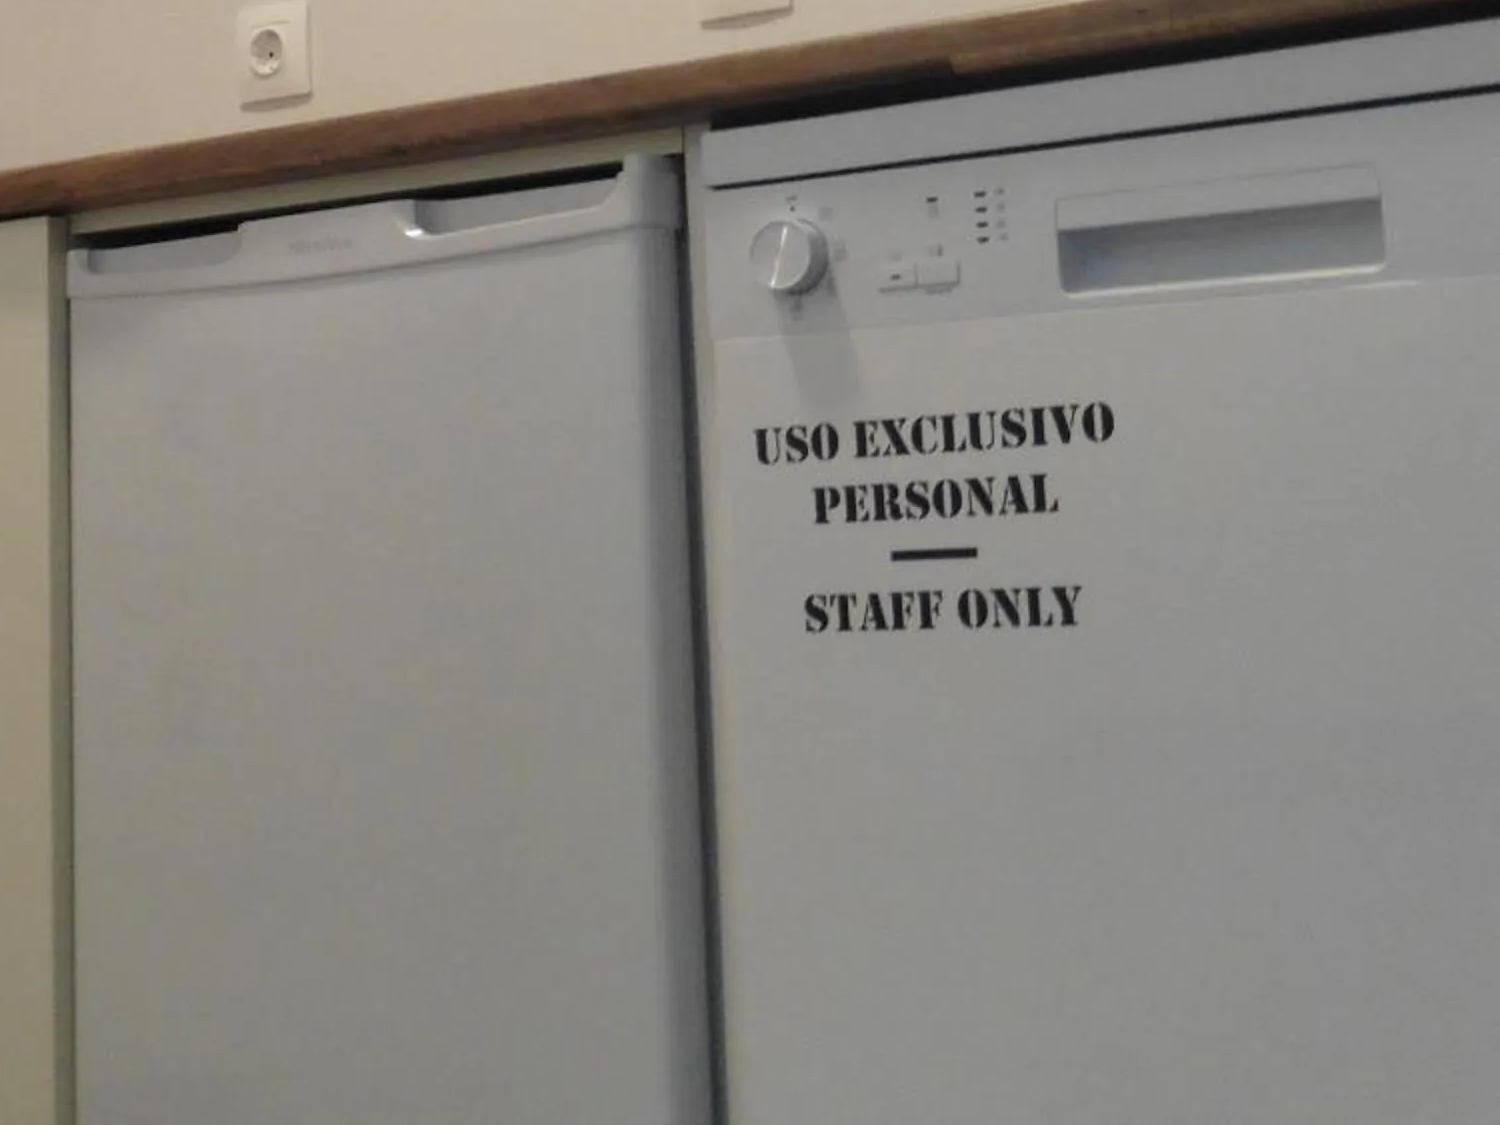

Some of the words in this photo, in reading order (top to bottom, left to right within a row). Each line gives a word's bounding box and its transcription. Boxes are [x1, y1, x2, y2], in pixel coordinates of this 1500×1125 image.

[754, 422, 840, 466] USO
[853, 401, 1115, 459] EXCLUSIVO
[813, 473, 1059, 525] PERSONAL
[803, 589, 944, 633] STAFF
[957, 585, 1082, 629] ONLY
